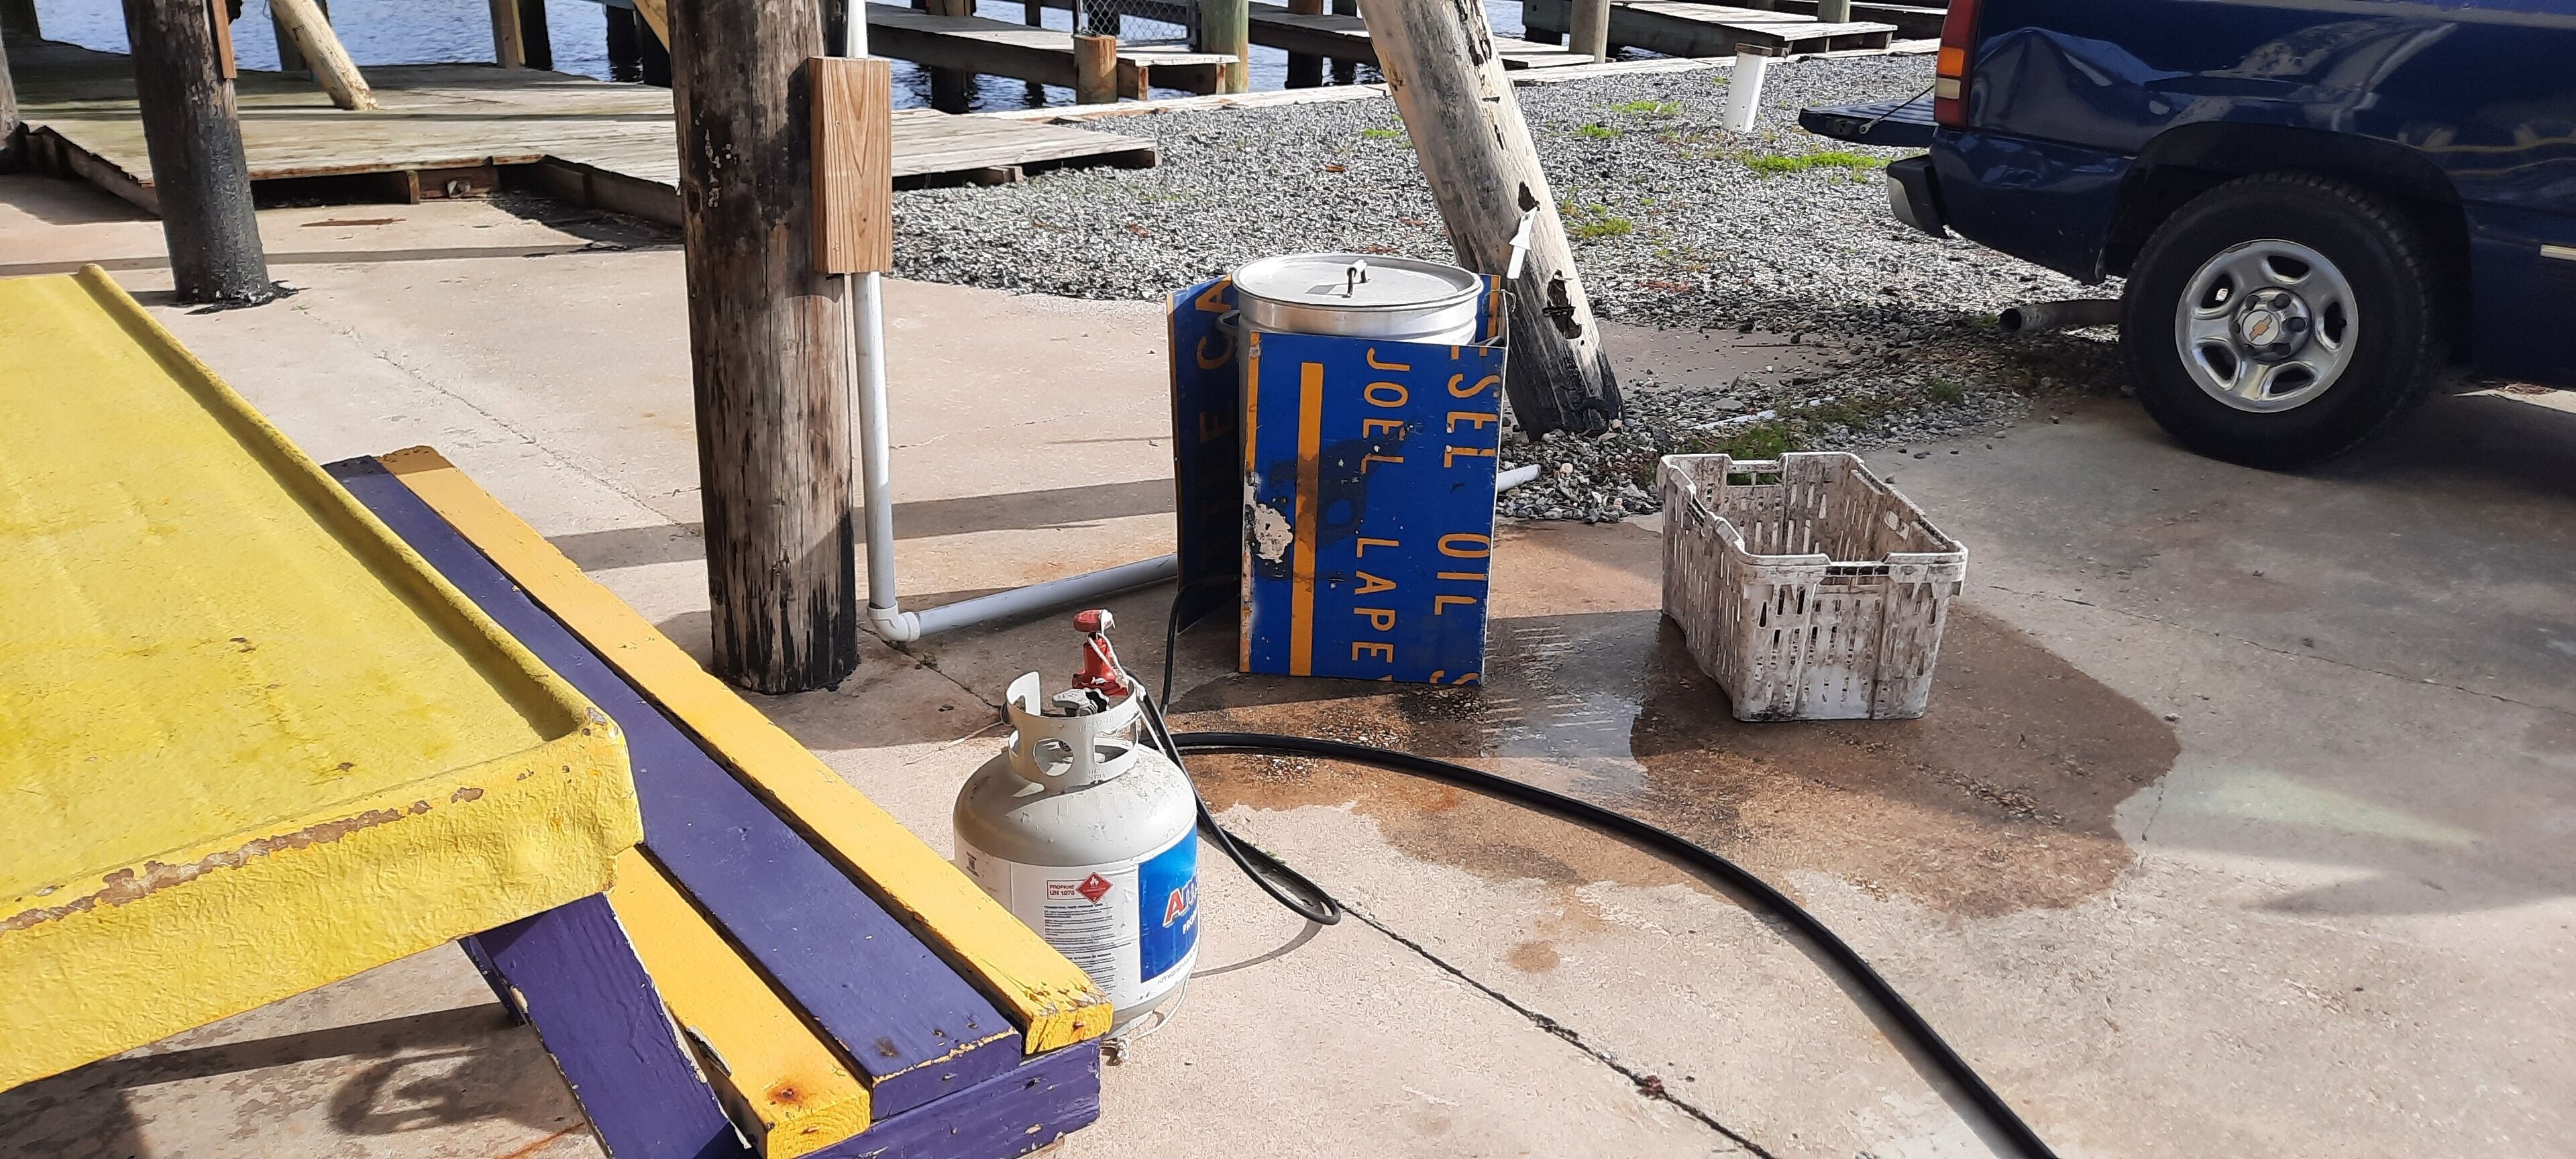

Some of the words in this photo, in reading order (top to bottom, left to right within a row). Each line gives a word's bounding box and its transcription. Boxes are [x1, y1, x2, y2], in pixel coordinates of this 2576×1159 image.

[1360, 347, 1410, 474] JOEL
[1352, 538, 1399, 682] LAPE
[1434, 533, 1491, 616] OIL
